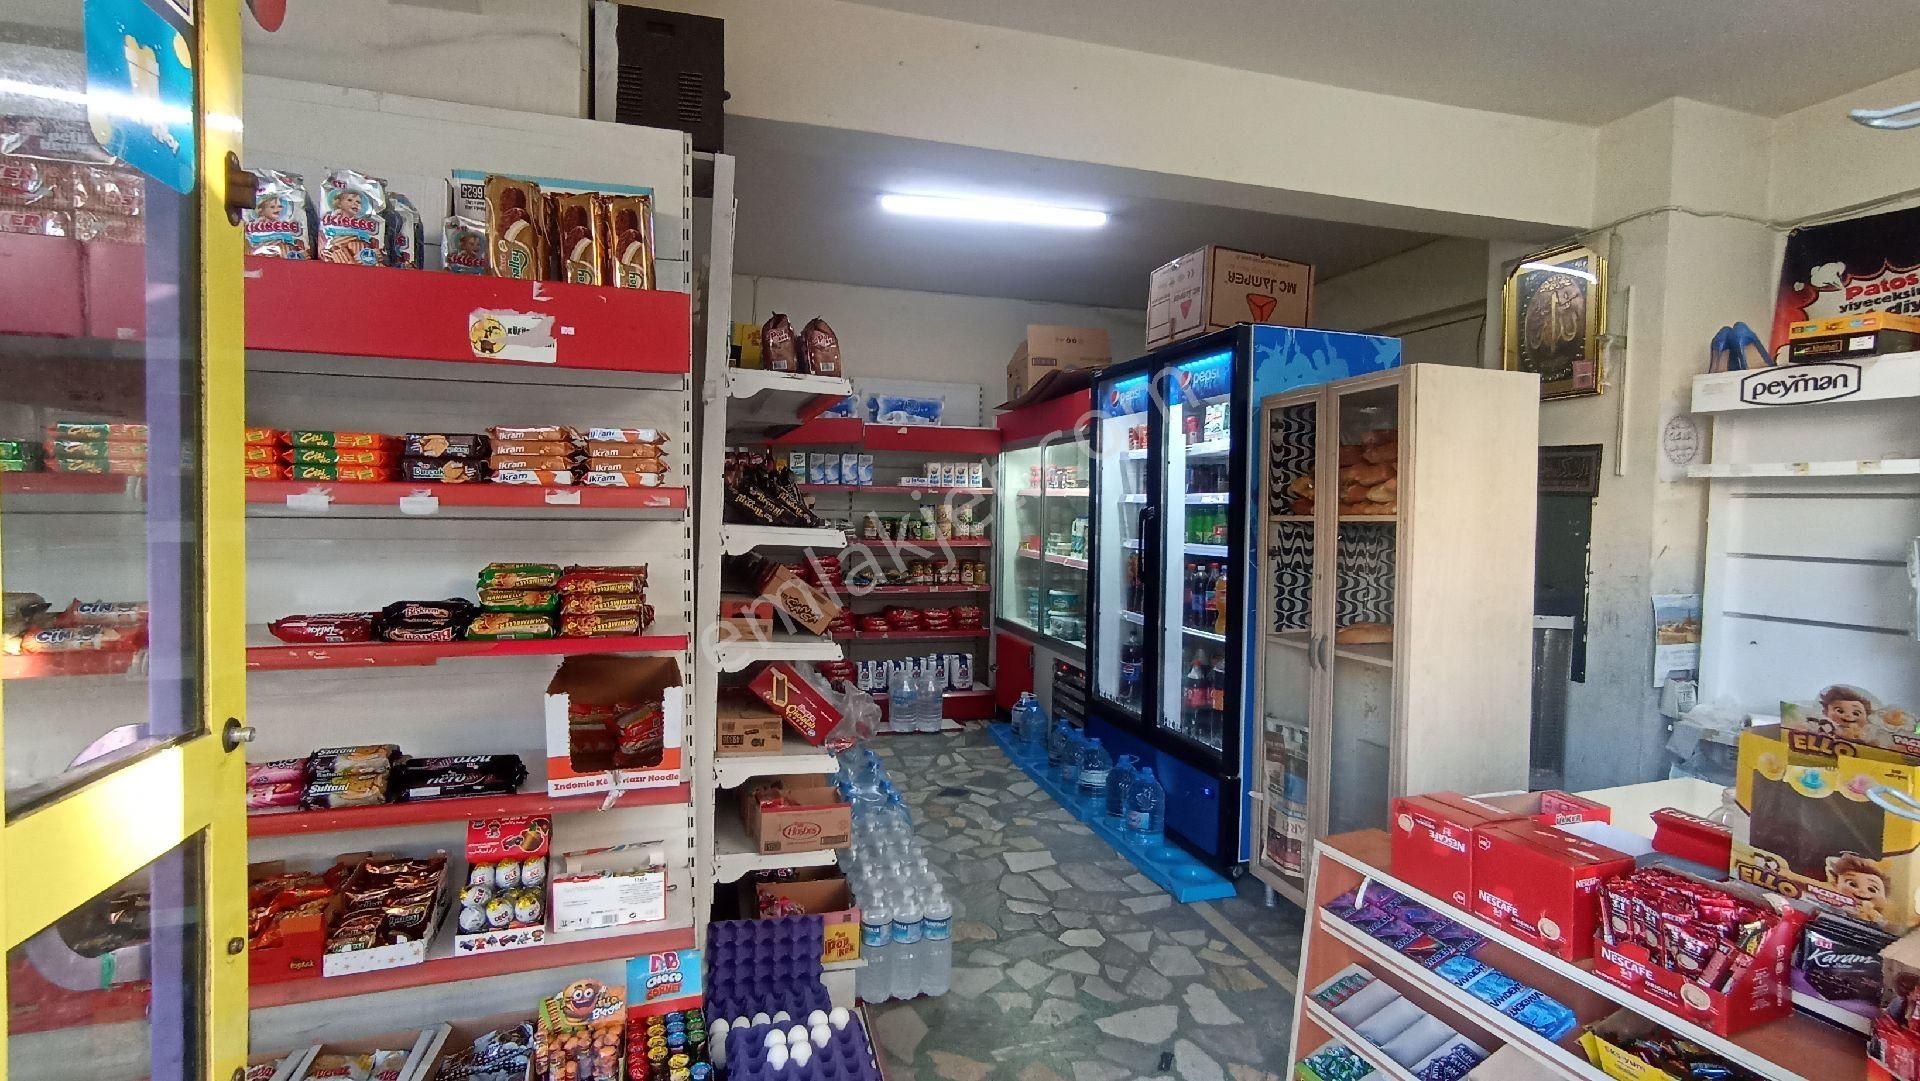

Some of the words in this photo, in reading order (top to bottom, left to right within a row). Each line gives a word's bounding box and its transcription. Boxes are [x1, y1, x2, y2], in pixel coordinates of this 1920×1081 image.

[1846, 273, 1919, 301] Patos
[1192, 370, 1220, 385] pepsi
[1752, 374, 1848, 400] peyman
[554, 780, 594, 791] Indomie
[648, 773, 679, 784] Noodle
[1808, 948, 1879, 967] Karam
[647, 972, 683, 988] CHOCO
[1490, 982, 1525, 1007] VIVIDENT
